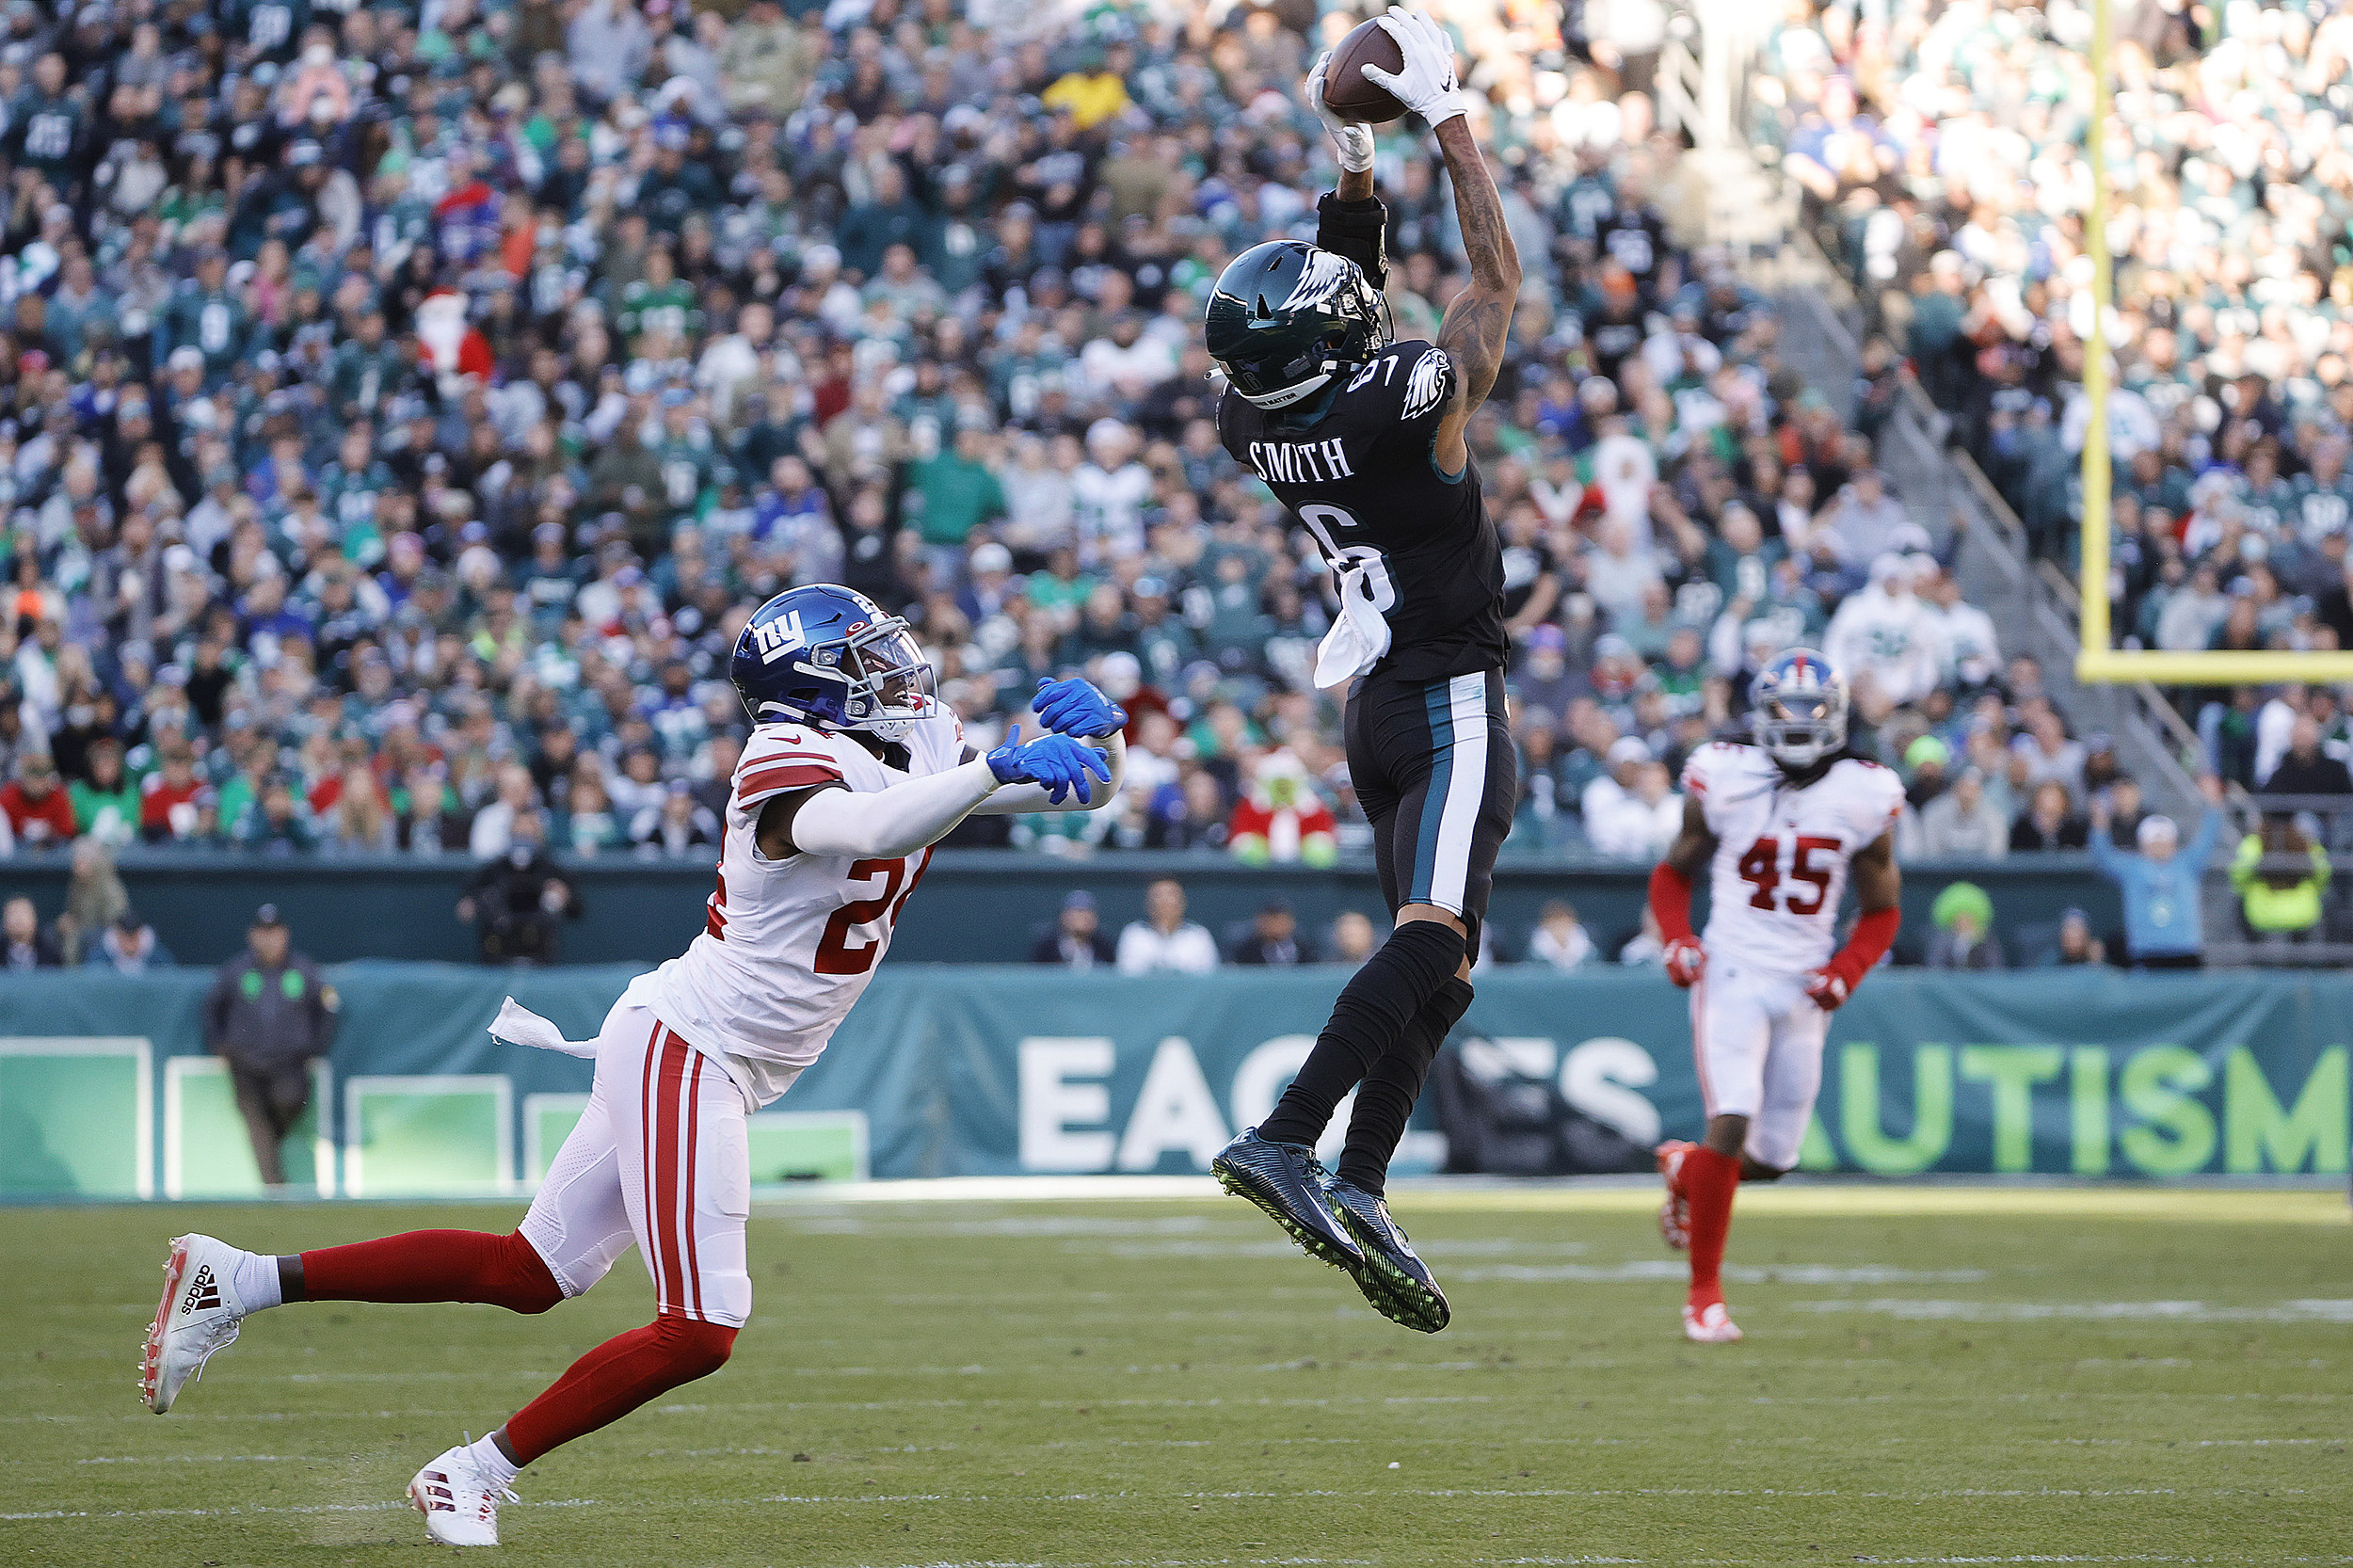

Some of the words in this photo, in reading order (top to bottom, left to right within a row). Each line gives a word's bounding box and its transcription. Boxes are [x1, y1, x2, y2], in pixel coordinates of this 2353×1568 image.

[1248, 437, 1355, 484] SMITH
[1298, 504, 1397, 613] 6
[813, 845, 935, 975] 2
[1738, 836, 1843, 916] 45
[1798, 1041, 2352, 1176] UTISM
[180, 1263, 212, 1316] adidas
